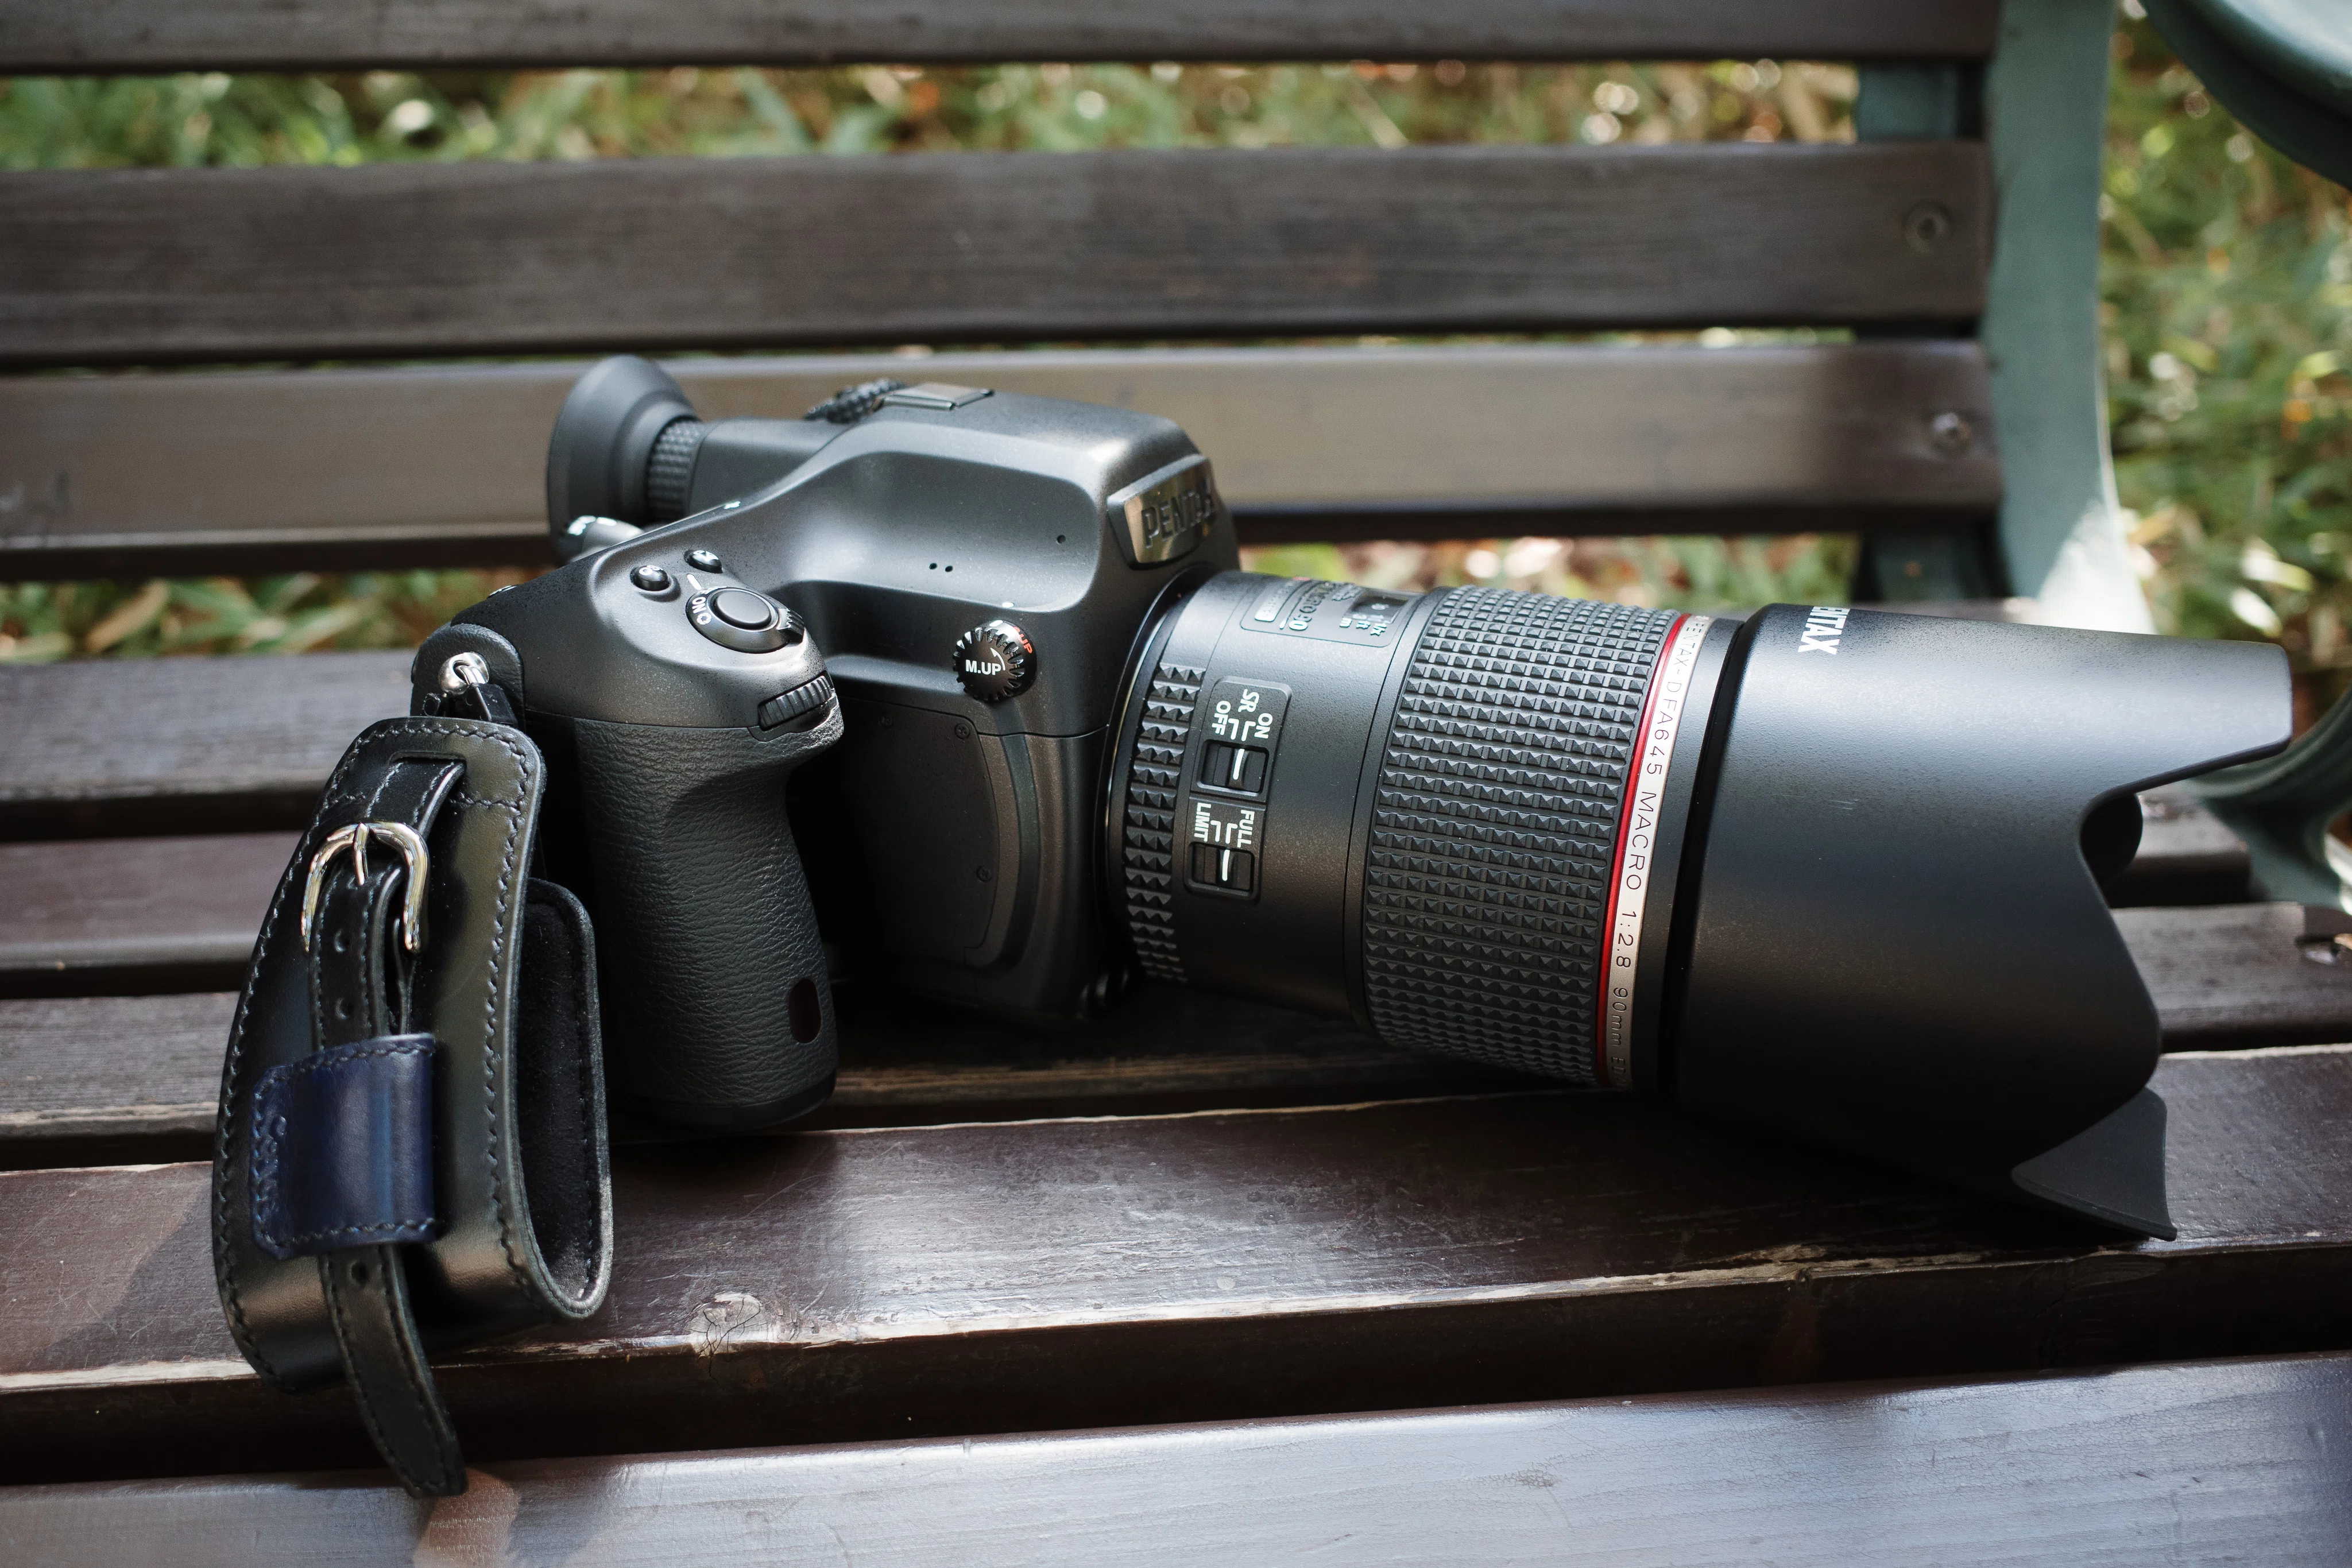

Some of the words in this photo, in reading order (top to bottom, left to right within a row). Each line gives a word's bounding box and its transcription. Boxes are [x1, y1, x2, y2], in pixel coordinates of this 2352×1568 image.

[692, 597, 707, 614] ON
[1339, 617, 1352, 628] m
[1797, 606, 1851, 655] ENTAX
[965, 659, 1001, 676] M.UP
[1212, 700, 1231, 735] OFF
[1237, 688, 1260, 713] SR
[1254, 713, 1273, 739] ON
[1194, 802, 1212, 842] LIMIT
[1237, 809, 1255, 848] FULL
[1626, 791, 1657, 890] MACRO
[1616, 911, 1637, 968] 1:2.8
[1611, 987, 1628, 1046] 90mm
